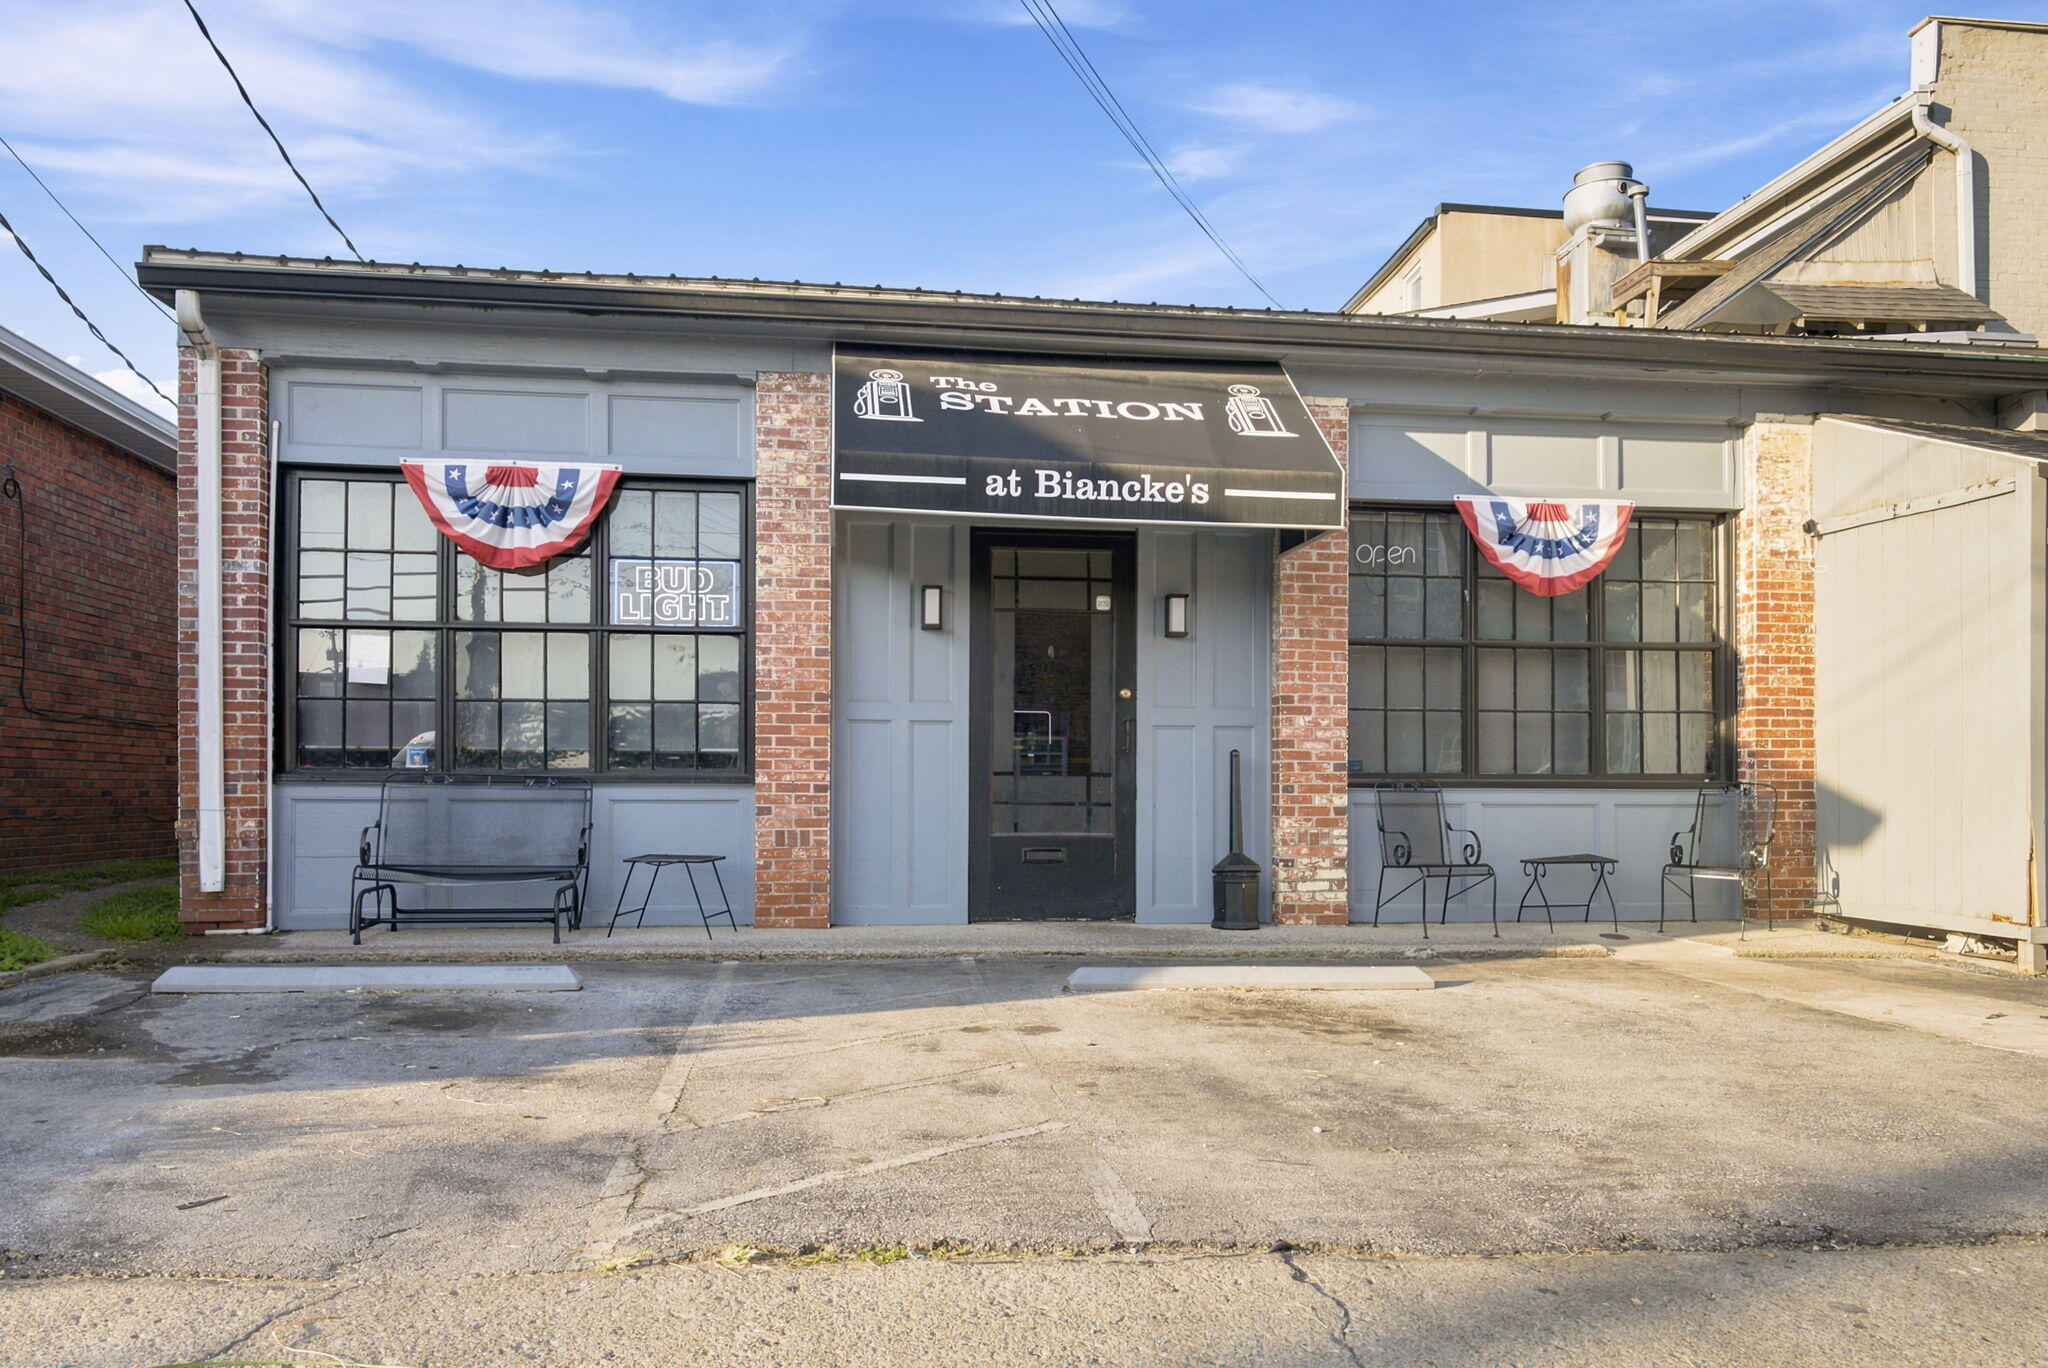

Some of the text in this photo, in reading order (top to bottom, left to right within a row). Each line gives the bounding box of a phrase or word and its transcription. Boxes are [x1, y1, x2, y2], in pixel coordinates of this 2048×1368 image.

[929, 376, 998, 393] The
[939, 391, 1205, 421] STATION
[985, 469, 1210, 504] at Biancke's
[635, 566, 714, 594] BUD
